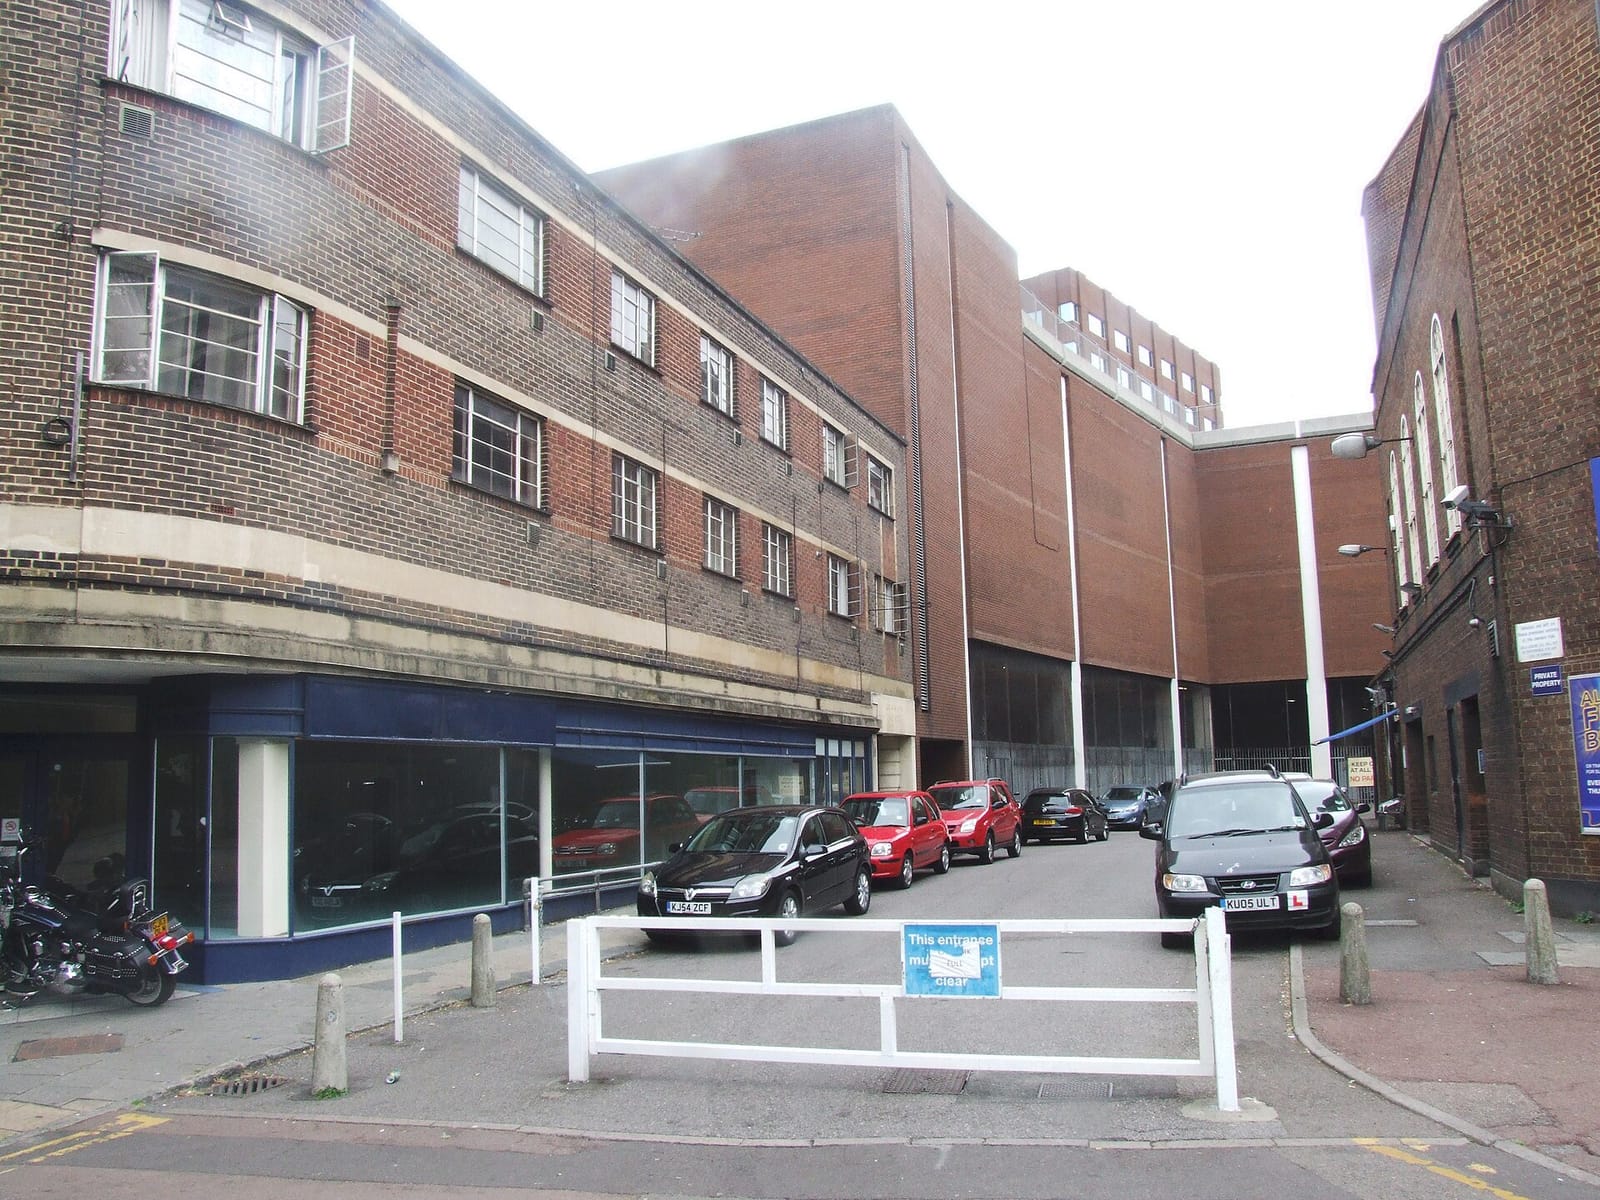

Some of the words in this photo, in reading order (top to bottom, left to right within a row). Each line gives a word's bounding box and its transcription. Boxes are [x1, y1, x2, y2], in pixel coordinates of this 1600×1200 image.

[1534, 671, 1558, 680] PRIVATE
[1532, 680, 1560, 688] PROPERTY
[1226, 898, 1254, 909] KU05
[1256, 897, 1277, 908] ULT
[1293, 895, 1303, 906] L
[671, 902, 691, 912] KJ54
[693, 903, 709, 912] ZCF
[908, 933, 935, 945] This
[937, 934, 993, 946] entrance
[935, 976, 968, 986] clear
